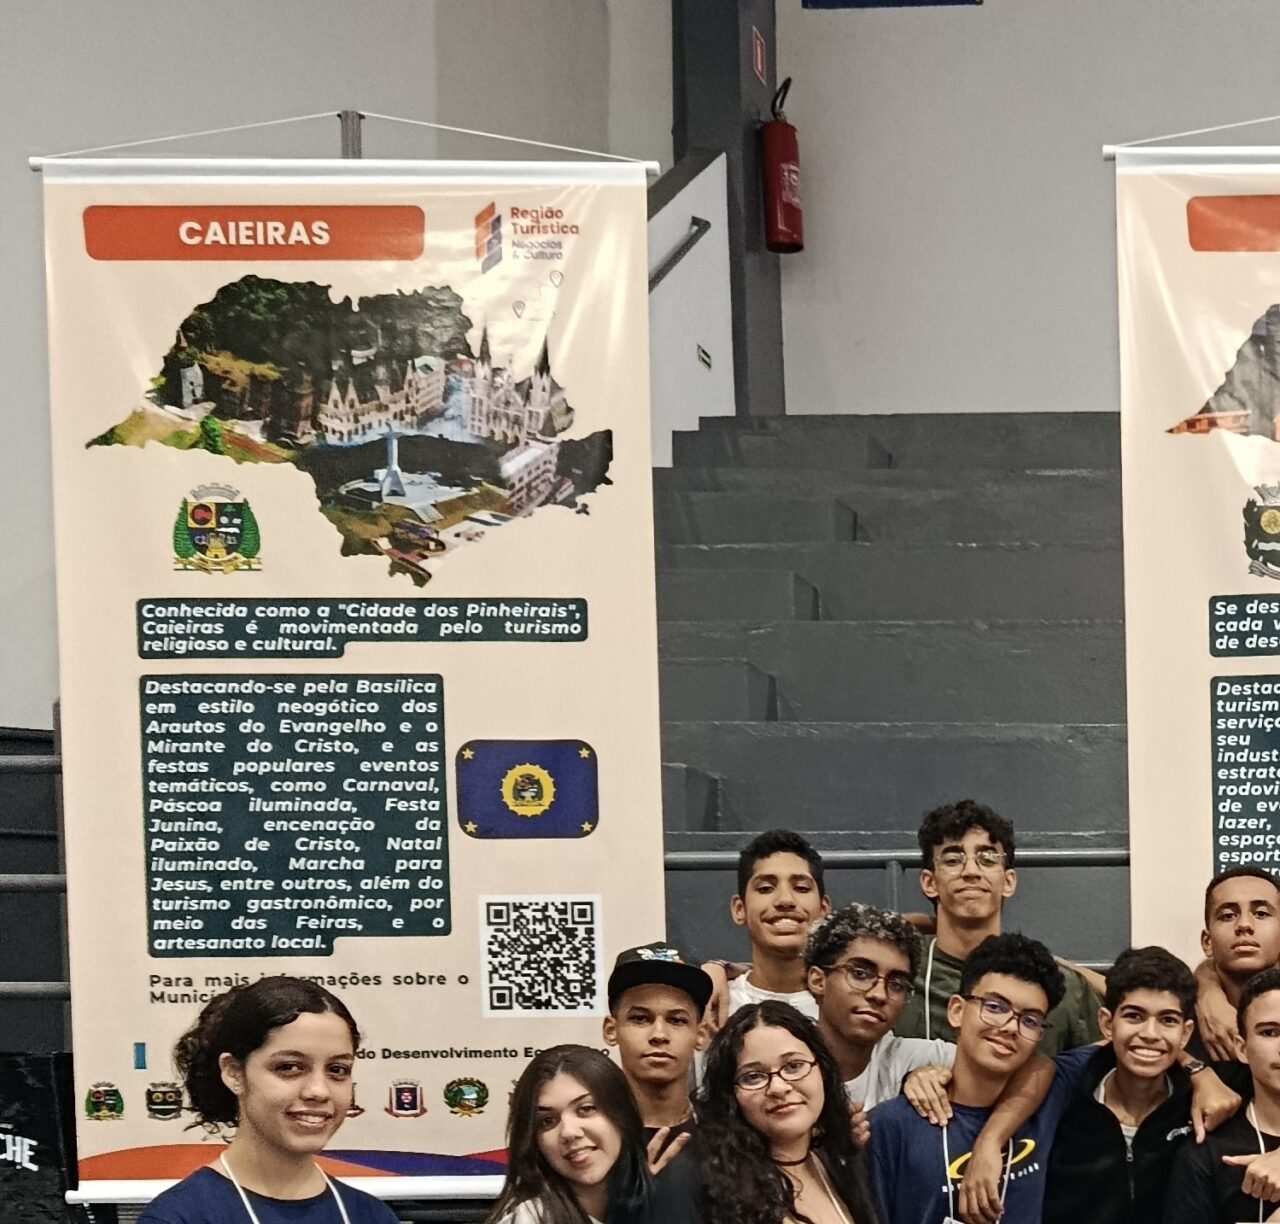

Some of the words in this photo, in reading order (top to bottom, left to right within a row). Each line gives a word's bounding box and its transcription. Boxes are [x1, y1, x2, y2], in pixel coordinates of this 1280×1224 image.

[510, 206, 564, 223] Região
[178, 219, 332, 248] CAIEIRAS
[511, 221, 580, 235] Turística
[141, 602, 248, 617] Conhecida
[254, 606, 311, 617] como
[316, 605, 331, 617] a
[338, 602, 417, 617] "Cidade
[423, 603, 459, 617] dos
[466, 602, 581, 621] Pinheirais",
[1214, 600, 1237, 615] Se
[142, 619, 225, 634] Caieiras
[245, 619, 259, 634] é
[279, 619, 419, 634] movimentada
[439, 619, 484, 636] pelo
[504, 619, 582, 634] turismo
[1215, 615, 1263, 633] cada
[143, 635, 230, 654] religioso
[234, 639, 247, 650] e
[252, 636, 338, 650] cultural.
[1215, 634, 1240, 649] de
[144, 678, 297, 694] Destacando-se
[303, 678, 349, 697] pela
[355, 678, 437, 694] Basílica
[145, 701, 177, 714] em
[197, 697, 256, 713] estilo
[277, 697, 380, 716] neogótico
[401, 698, 438, 713] dos
[1216, 734, 1251, 746] seu
[147, 757, 210, 773] festas
[232, 757, 336, 775] populares
[359, 759, 440, 773] eventos
[153, 935, 266, 950] artesanato
[271, 933, 327, 948] local.
[149, 974, 194, 988] Para
[392, 972, 447, 986] sobre
[457, 974, 470, 986] o
[381, 1047, 518, 1060] Desenvolvimento
